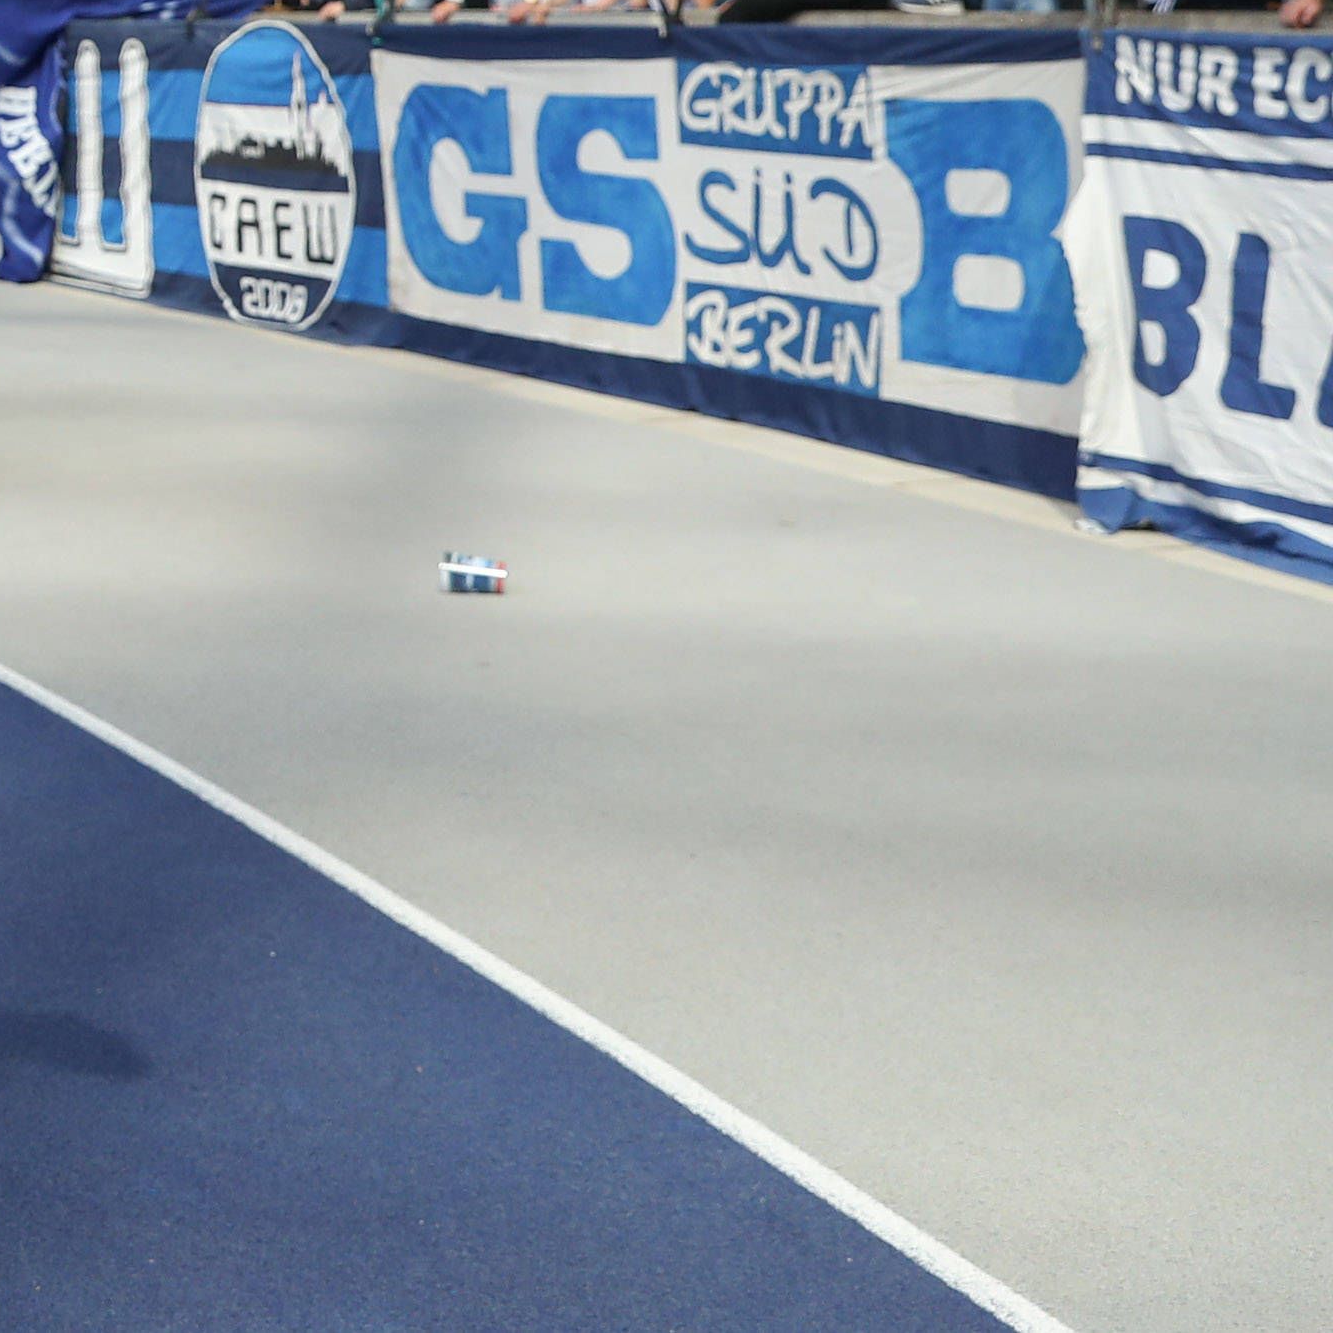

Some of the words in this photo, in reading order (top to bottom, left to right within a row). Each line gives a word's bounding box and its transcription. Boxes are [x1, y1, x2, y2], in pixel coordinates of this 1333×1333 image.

[680, 62, 874, 148] GRUPPA
[1115, 35, 1239, 118] NUR
[1252, 46, 1333, 124] EC
[1123, 215, 1333, 428] BL
